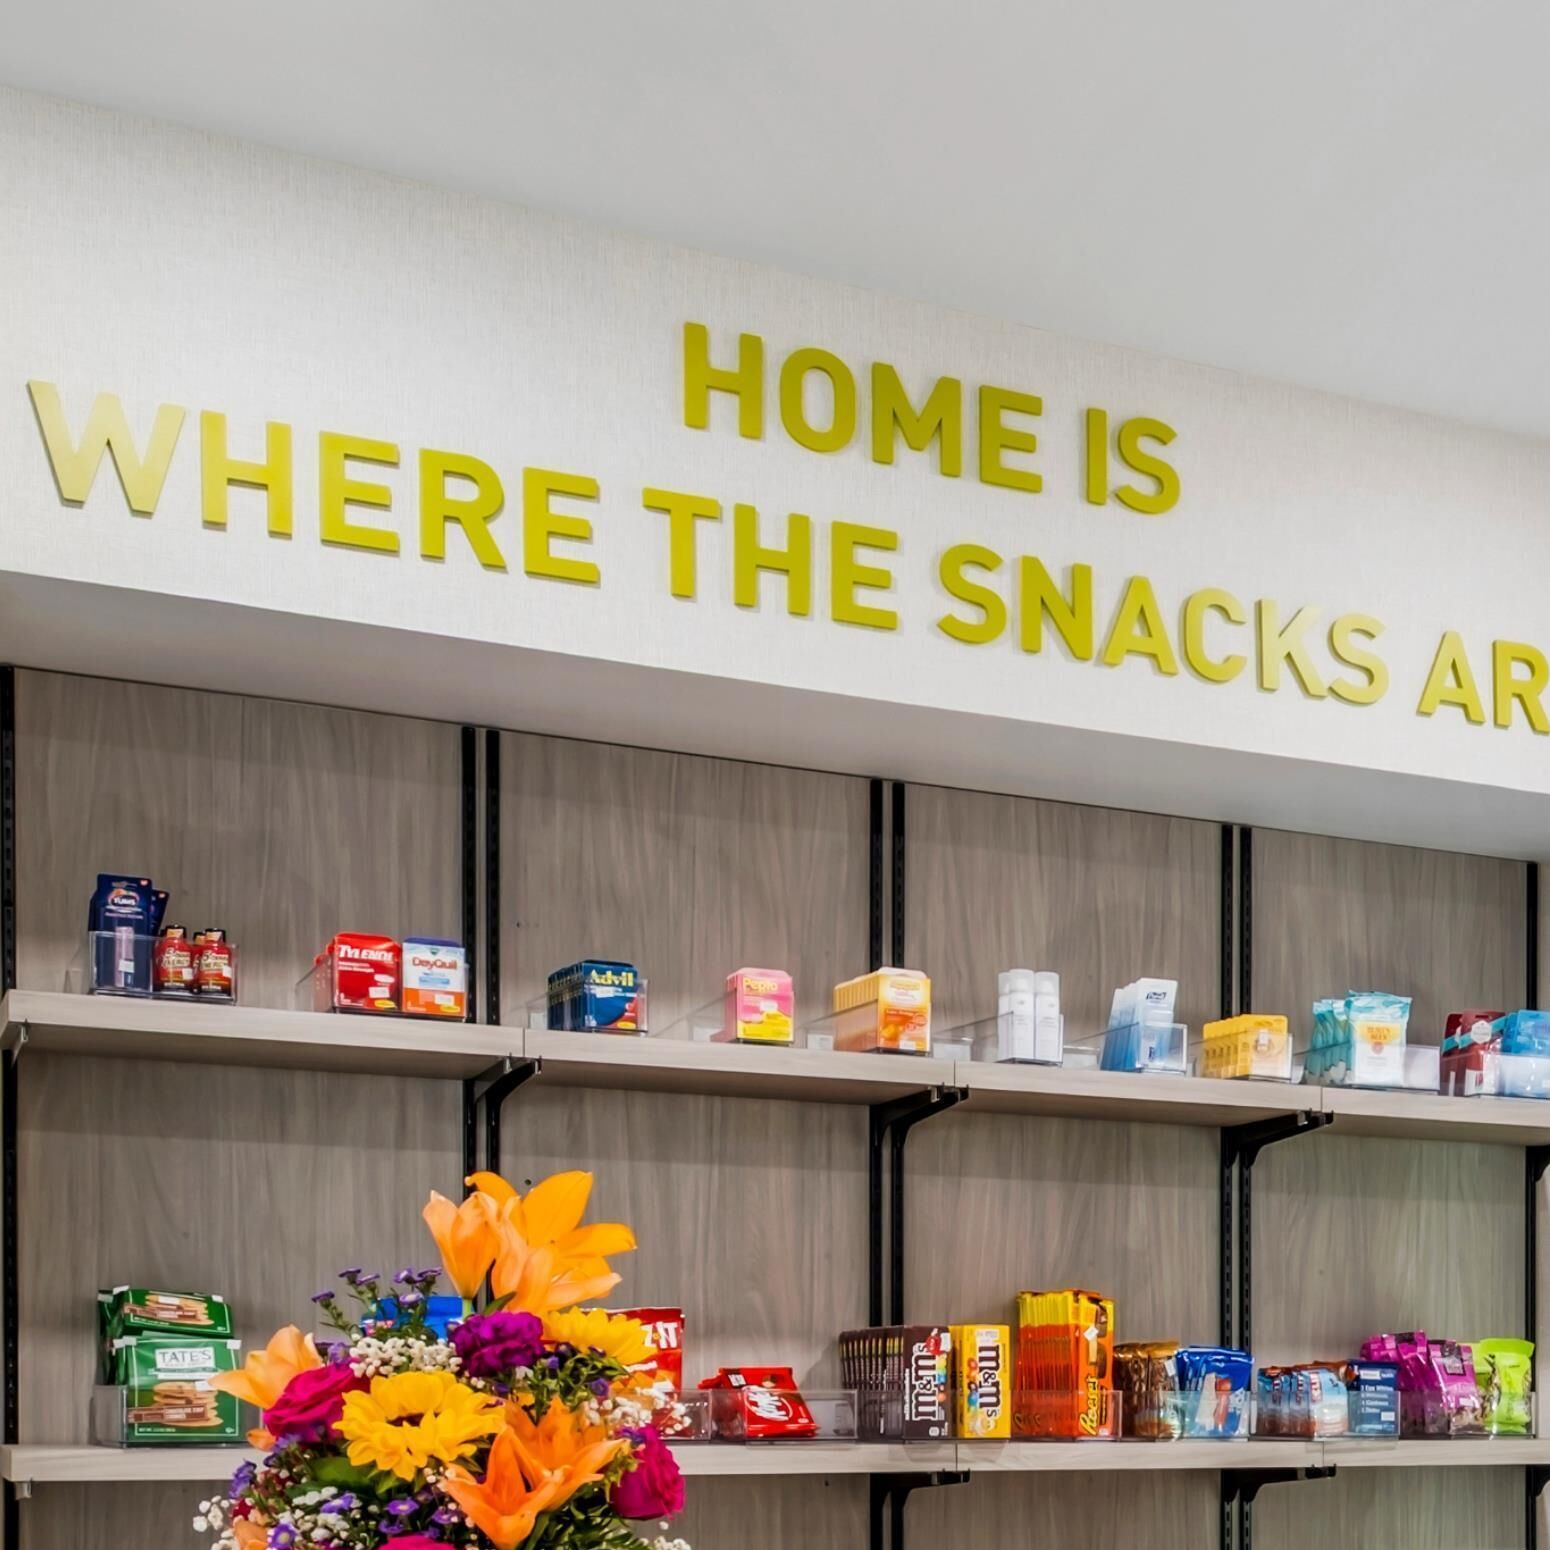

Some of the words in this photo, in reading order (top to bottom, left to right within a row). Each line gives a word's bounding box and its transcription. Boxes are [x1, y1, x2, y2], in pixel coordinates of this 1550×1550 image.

[681, 321, 1043, 494] HOME
[1085, 407, 1181, 514] IS
[26, 380, 602, 584] WHERE
[643, 487, 899, 631] THE
[935, 543, 1390, 705] SNACKS
[339, 945, 394, 960] TYLENOL
[412, 957, 458, 971] DayQuil
[590, 969, 634, 987] Advil
[742, 977, 778, 993] Pepto
